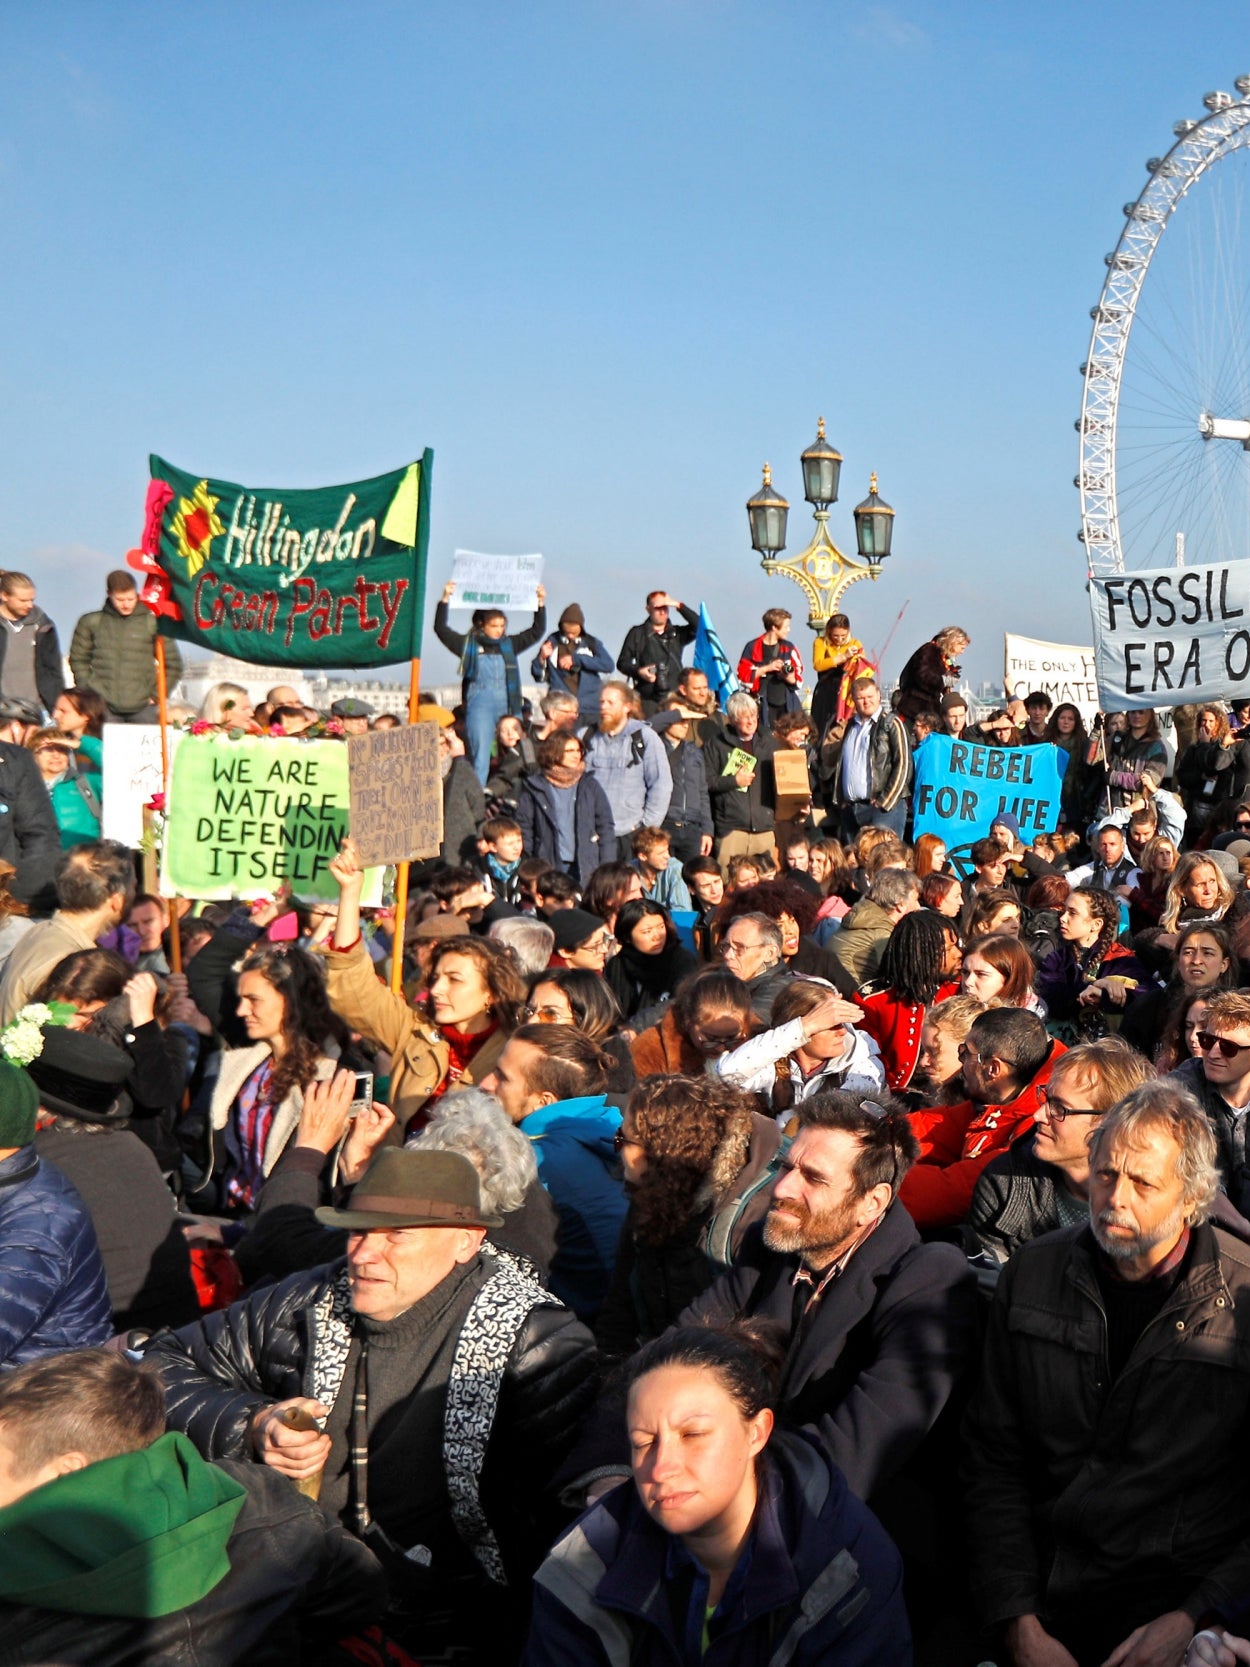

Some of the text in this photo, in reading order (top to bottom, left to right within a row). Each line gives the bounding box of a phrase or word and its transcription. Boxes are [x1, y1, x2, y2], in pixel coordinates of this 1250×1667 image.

[224, 493, 376, 588] Hillingdon
[194, 571, 279, 635] Green
[284, 576, 409, 649] Party
[1104, 569, 1244, 630] FOSSIL
[1011, 658, 1037, 671] THE
[1042, 661, 1077, 673] ONLY
[1124, 638, 1202, 694] ERA
[213, 758, 319, 785] WE ARE
[950, 743, 1033, 784] REBEL
[214, 789, 337, 821] NATURE
[918, 785, 978, 822] FOR
[197, 818, 349, 849] DEFENDIN
[208, 847, 331, 882] ITSELF
